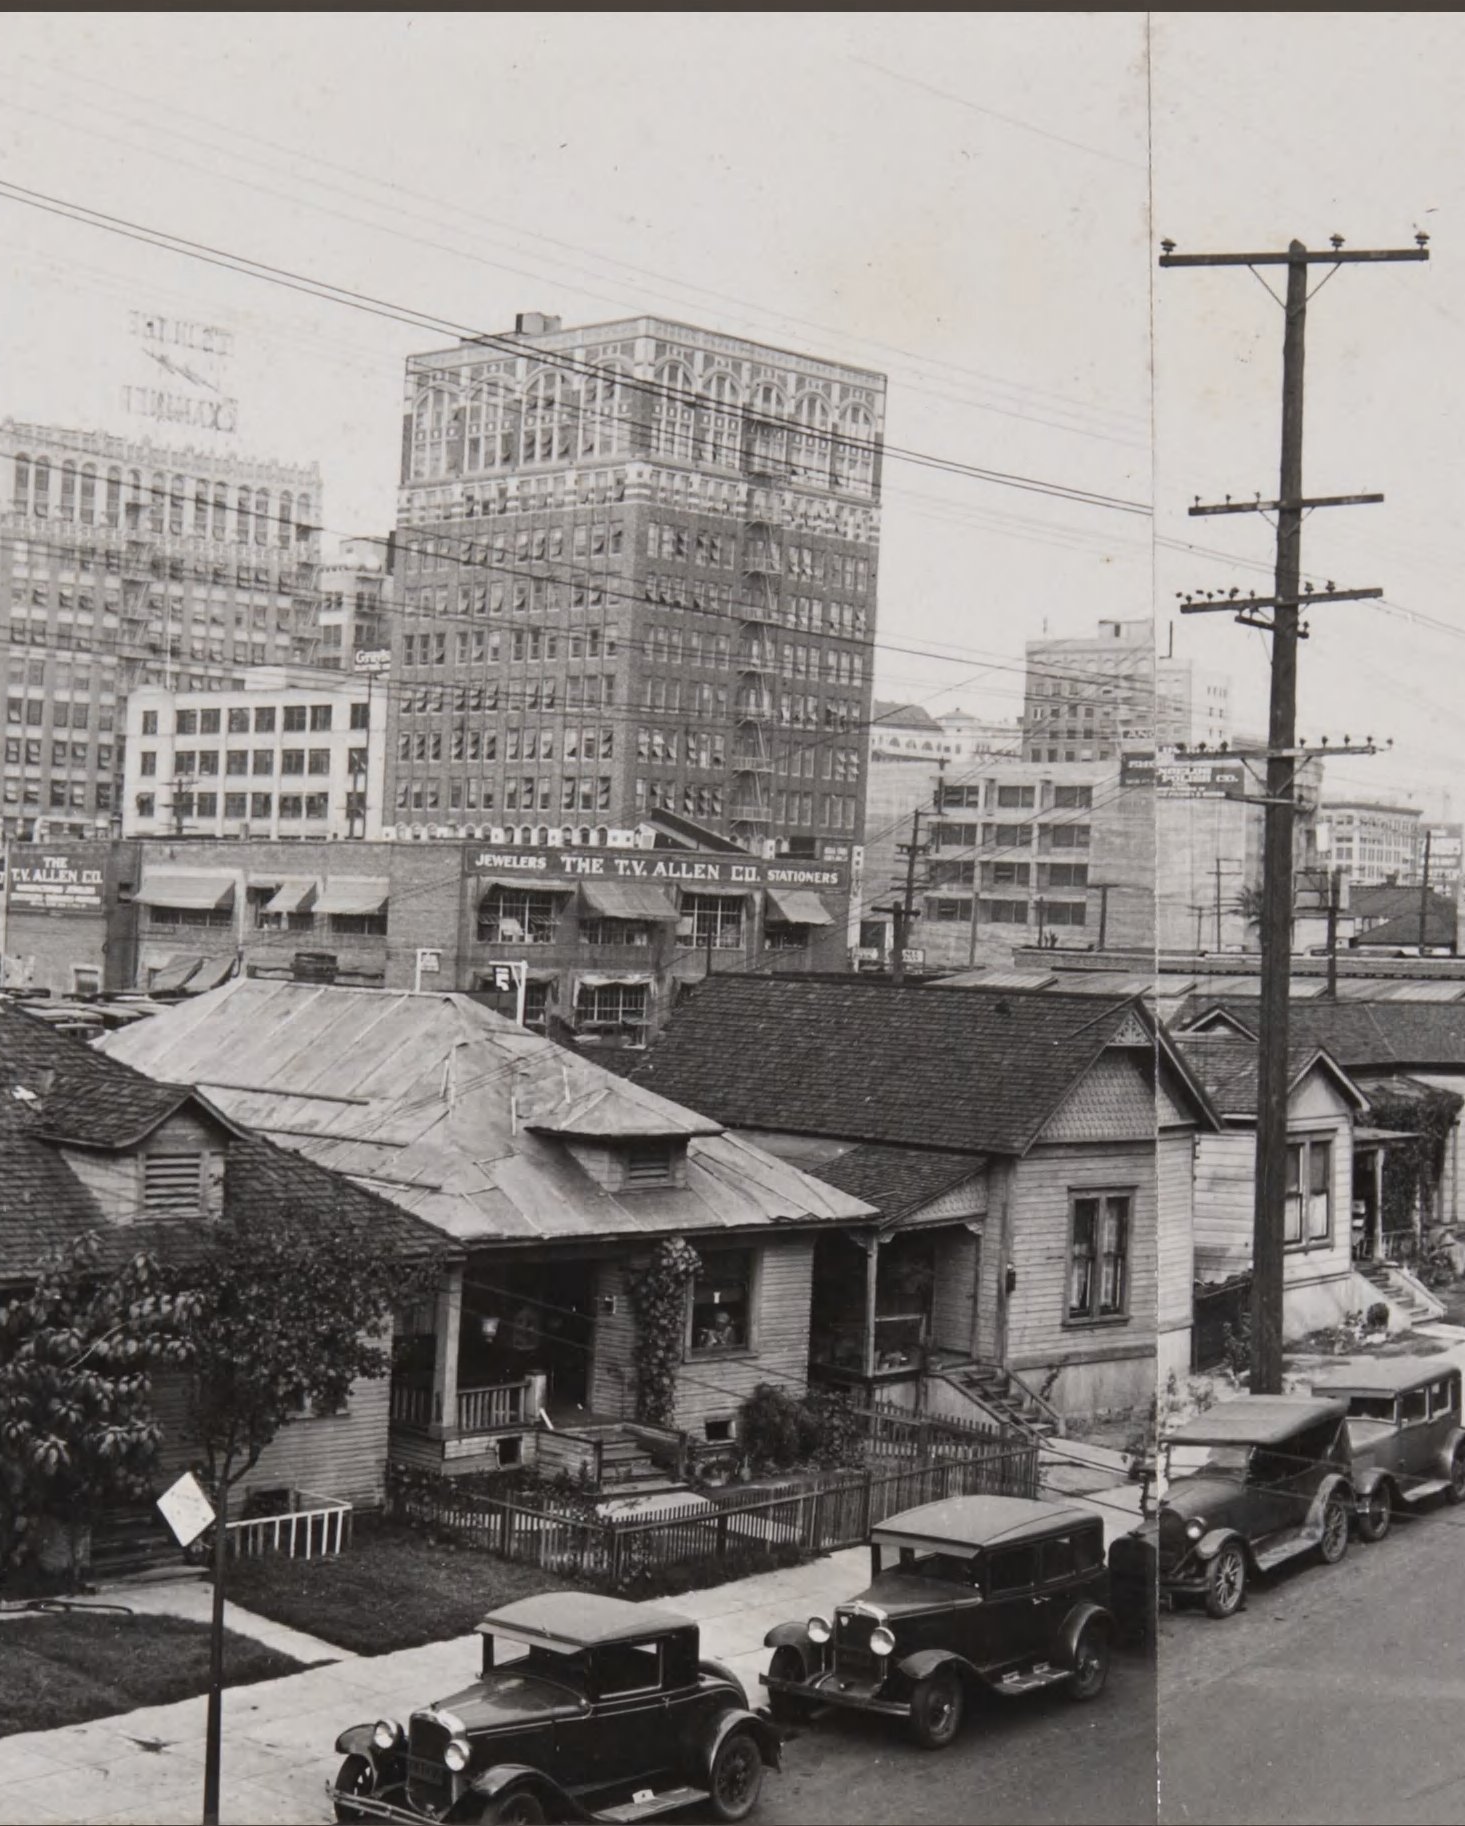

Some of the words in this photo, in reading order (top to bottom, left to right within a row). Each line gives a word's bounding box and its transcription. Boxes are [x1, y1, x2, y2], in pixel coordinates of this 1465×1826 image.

[43, 857, 68, 869] THE
[475, 853, 547, 871] JEWELERS
[560, 856, 604, 876] THE
[614, 858, 648, 877] T.V.
[653, 860, 720, 881] ALLEN
[730, 864, 761, 883] CO.
[767, 869, 838, 886] STATIONERS
[33, 869, 78, 883] ALLEN
